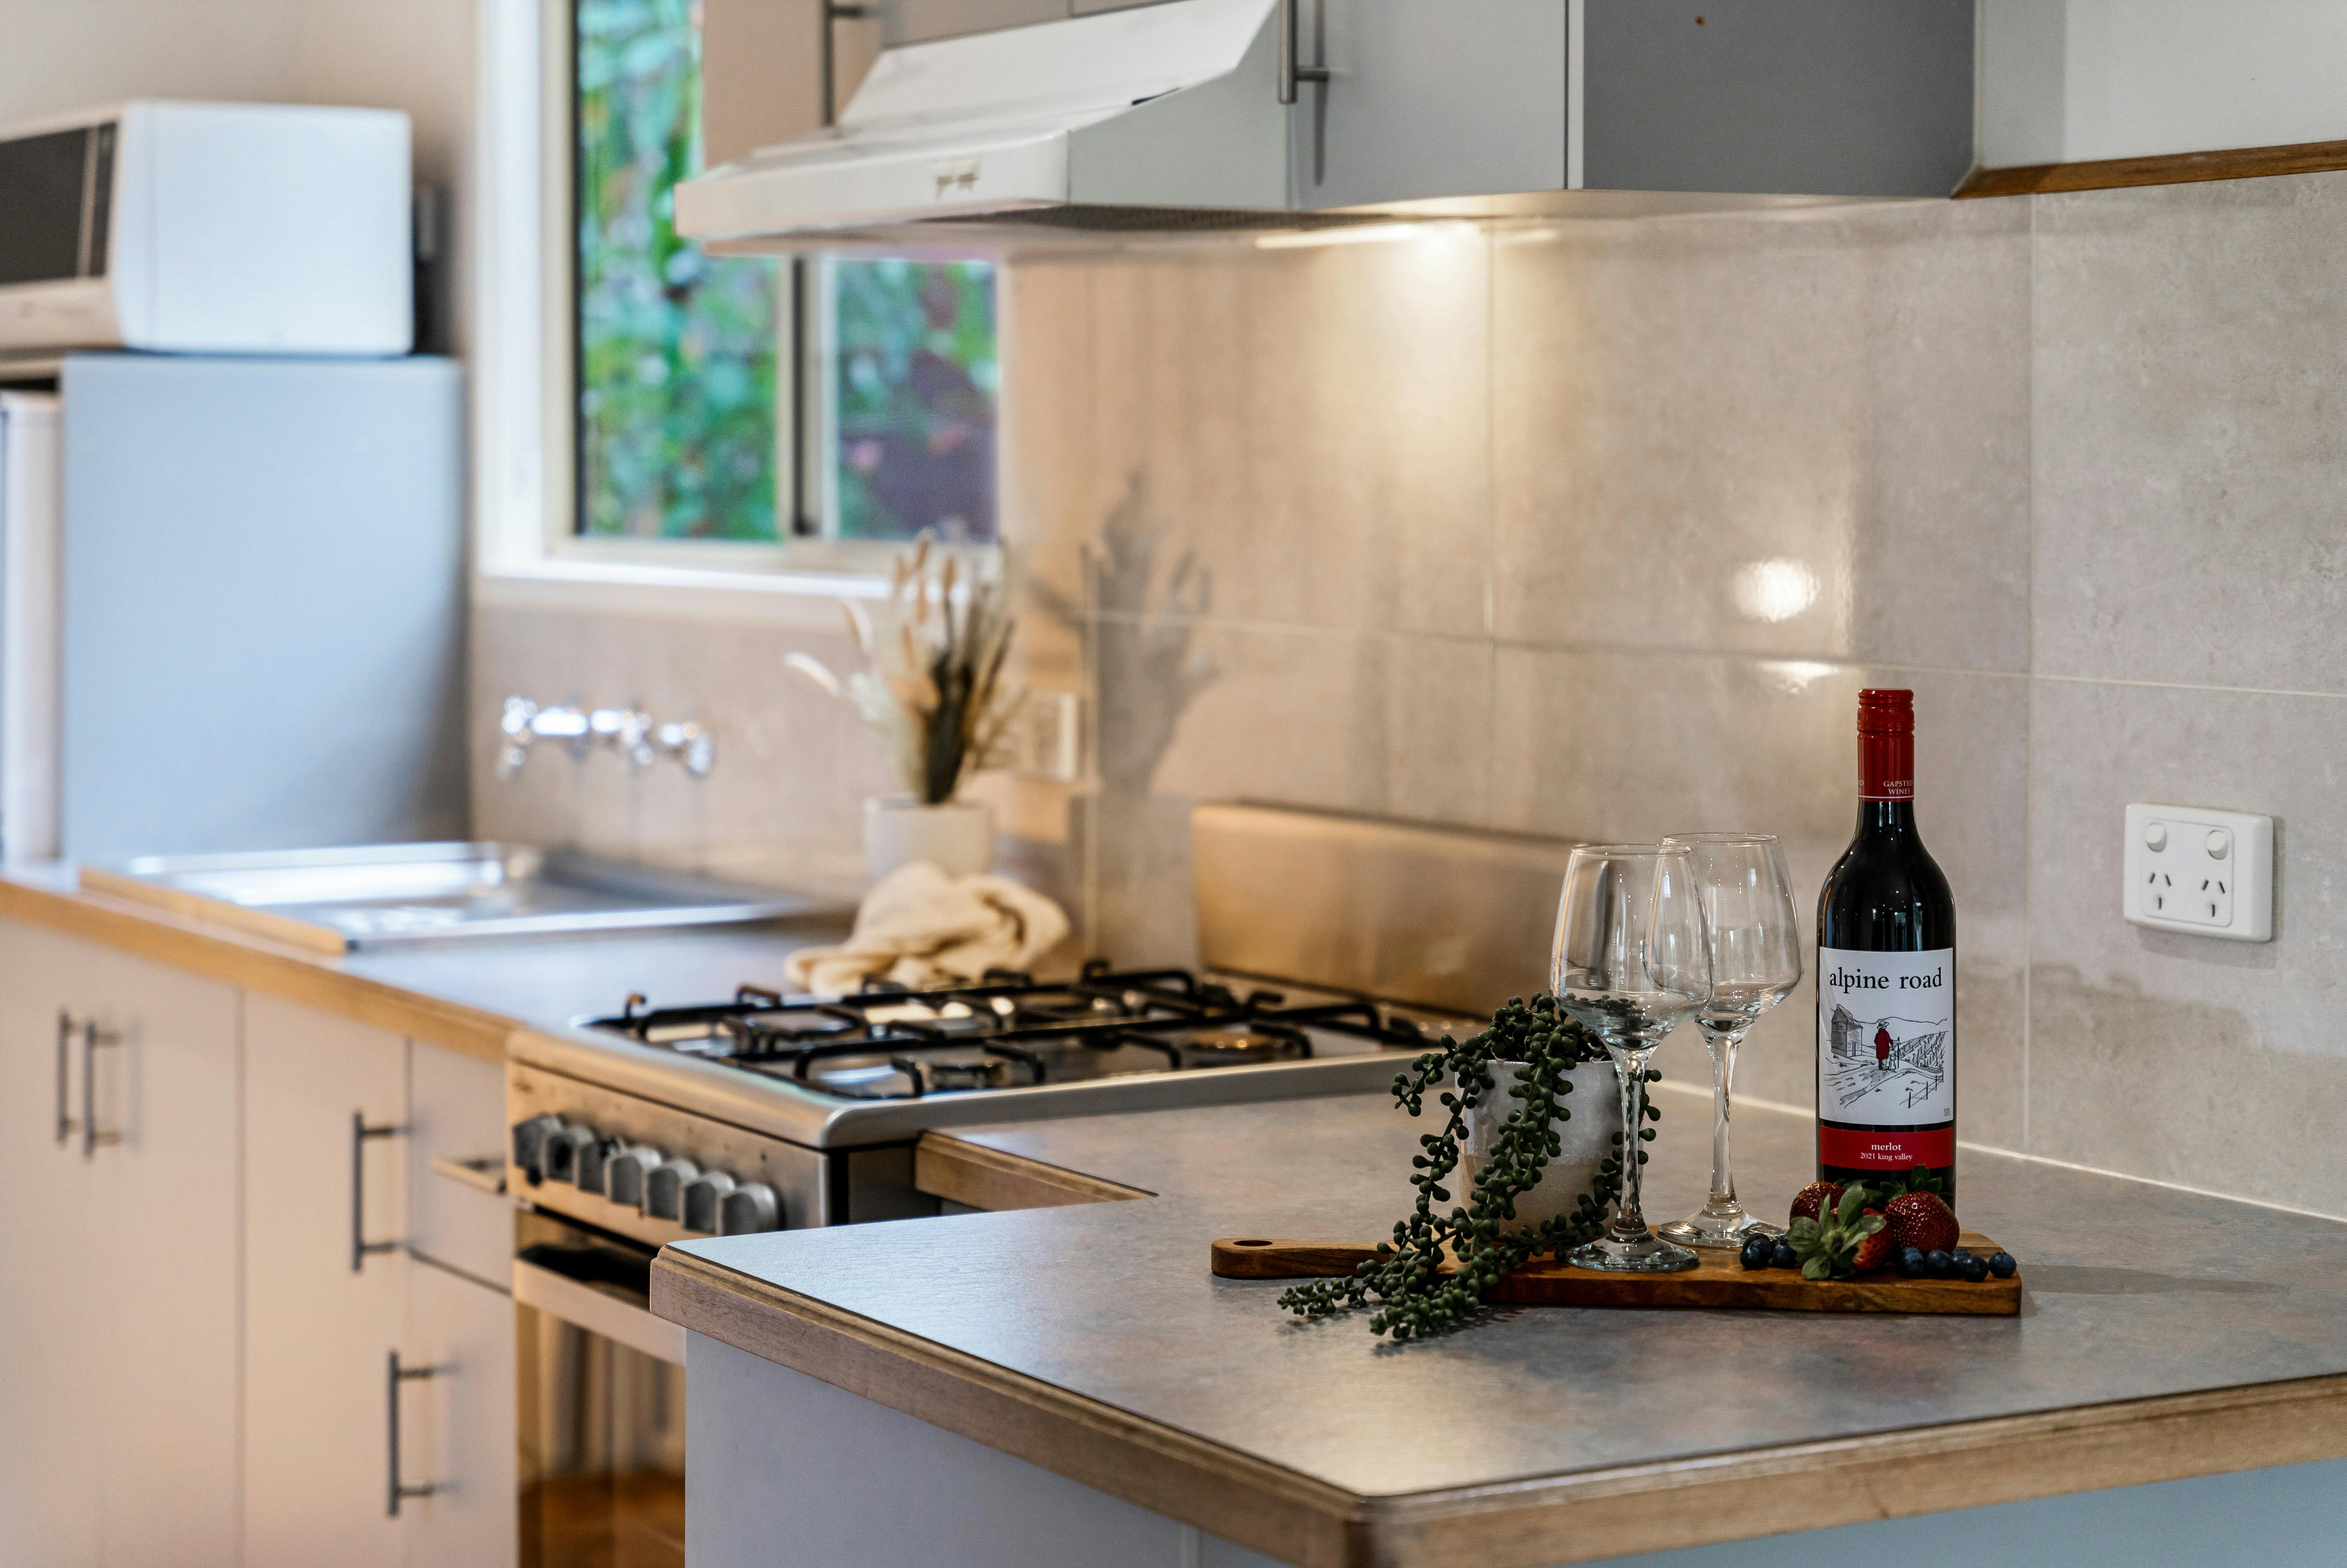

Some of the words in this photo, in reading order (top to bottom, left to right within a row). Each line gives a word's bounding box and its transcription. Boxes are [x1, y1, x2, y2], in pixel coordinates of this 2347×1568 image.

[1830, 967, 1889, 994] alpine
[1899, 967, 1942, 989] road
[1878, 1153, 1893, 1161] king
